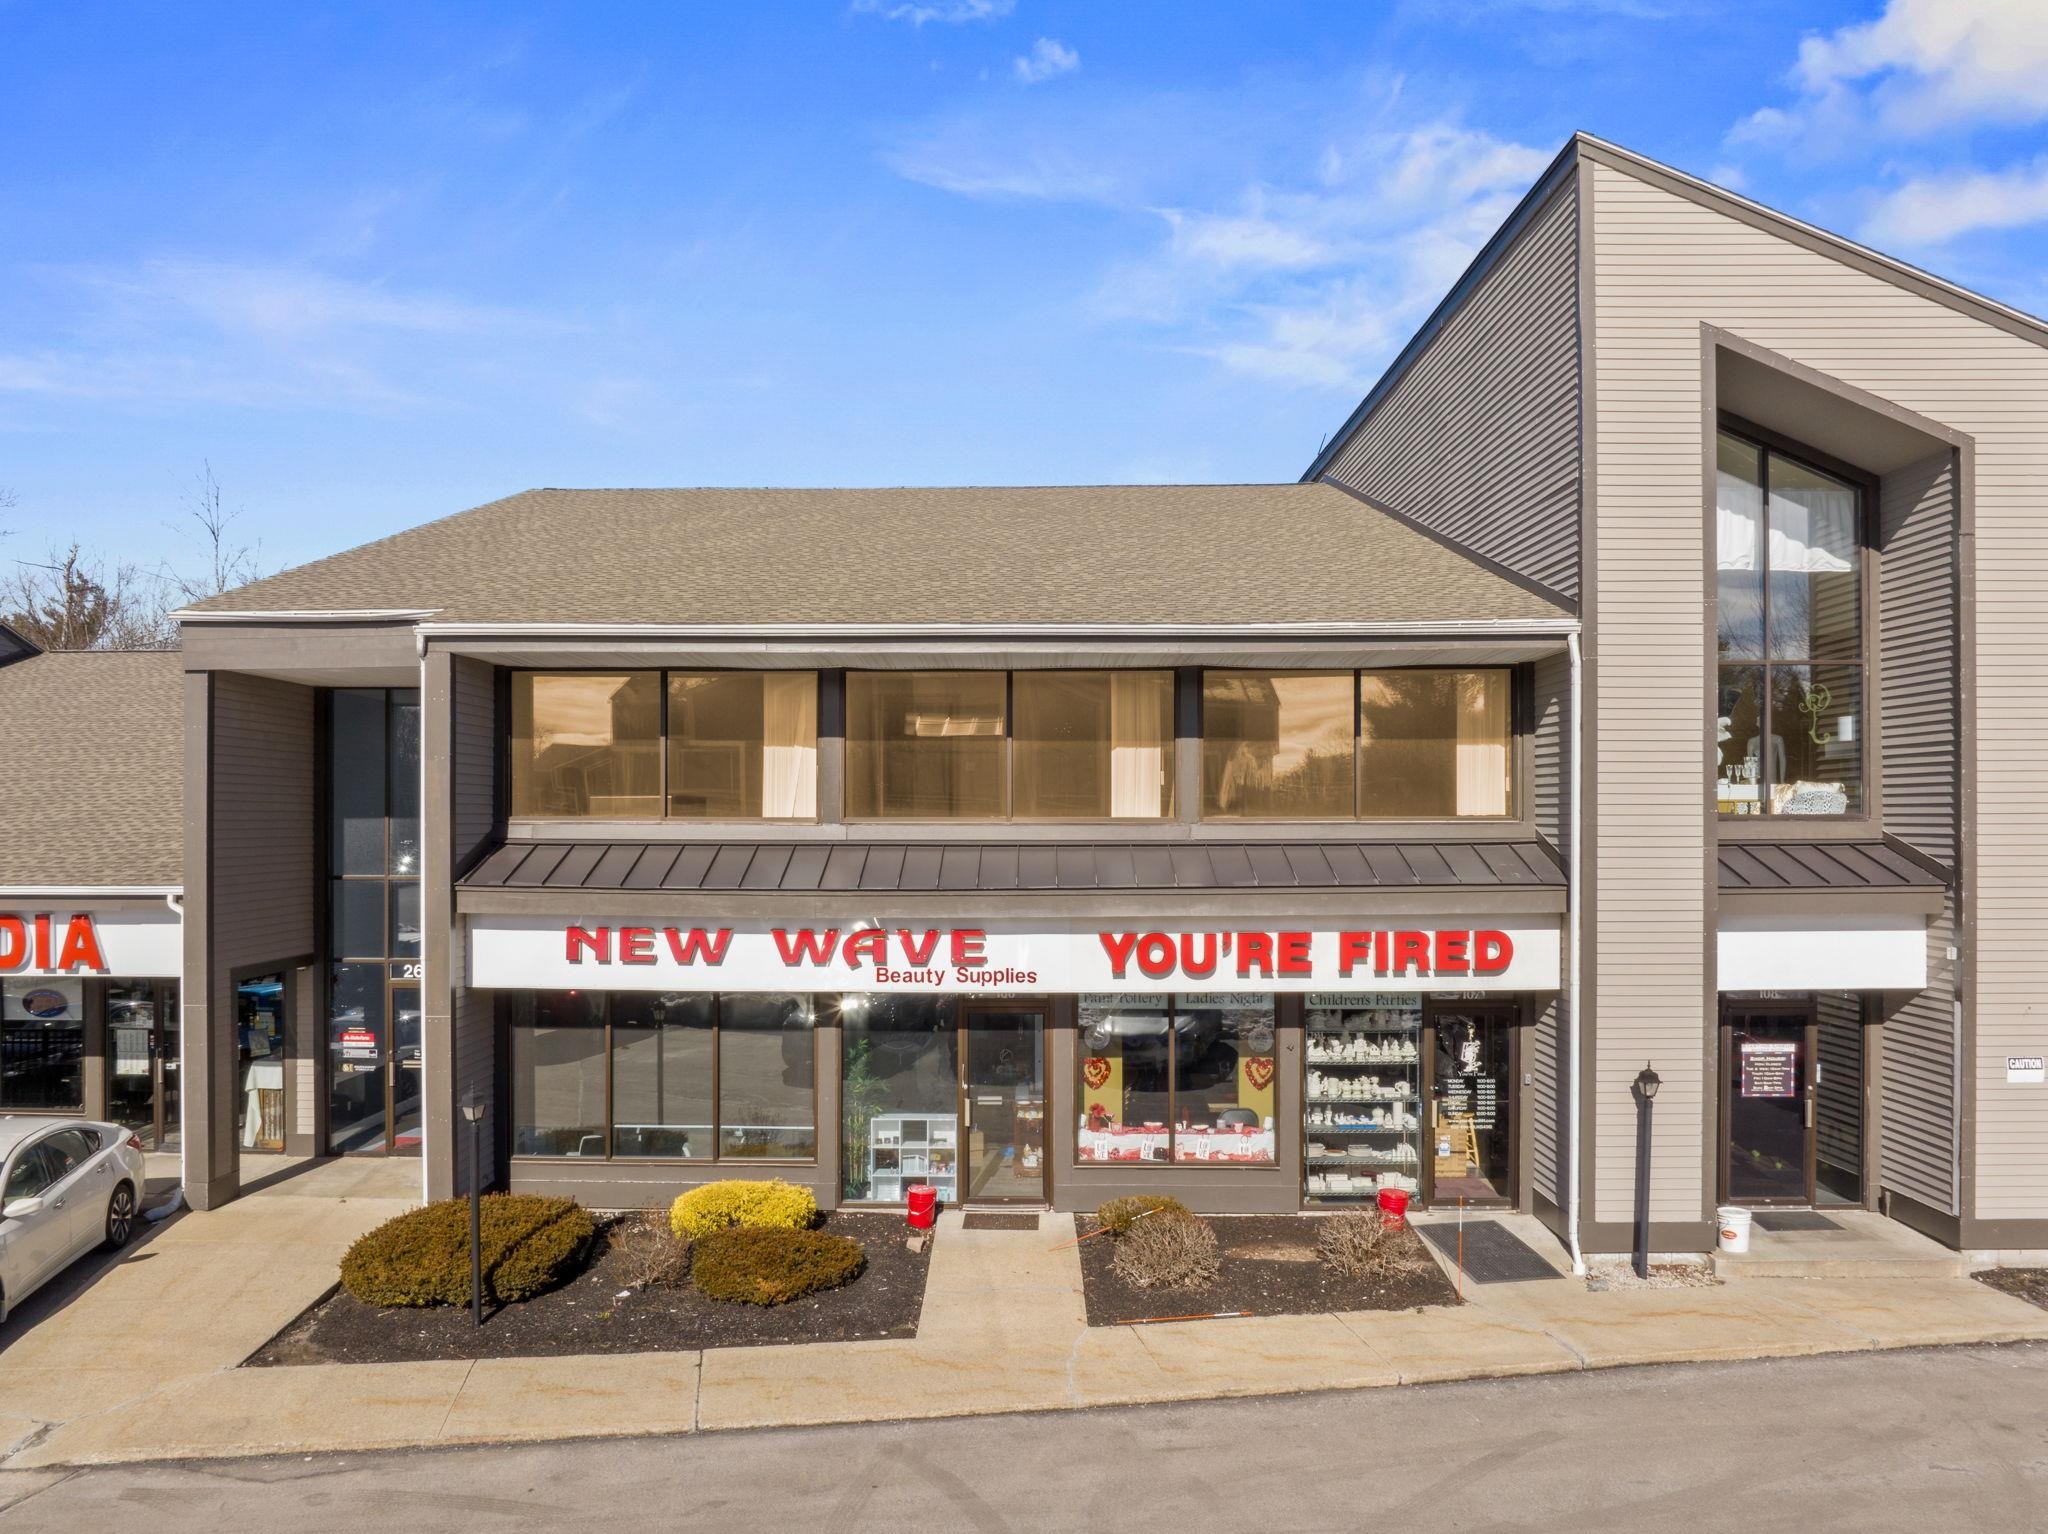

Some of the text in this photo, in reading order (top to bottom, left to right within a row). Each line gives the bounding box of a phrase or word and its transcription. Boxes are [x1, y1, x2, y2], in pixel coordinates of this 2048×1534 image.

[565, 928, 986, 968] NEW WAVE
[1099, 930, 1514, 975] YOU'RE FIRED
[876, 967, 1037, 986] Beauty Supplies
[1185, 993, 1264, 1006] Ladies Night
[1309, 993, 1417, 1006] Children's Parties
[2009, 1059, 2042, 1069] CAUTION
